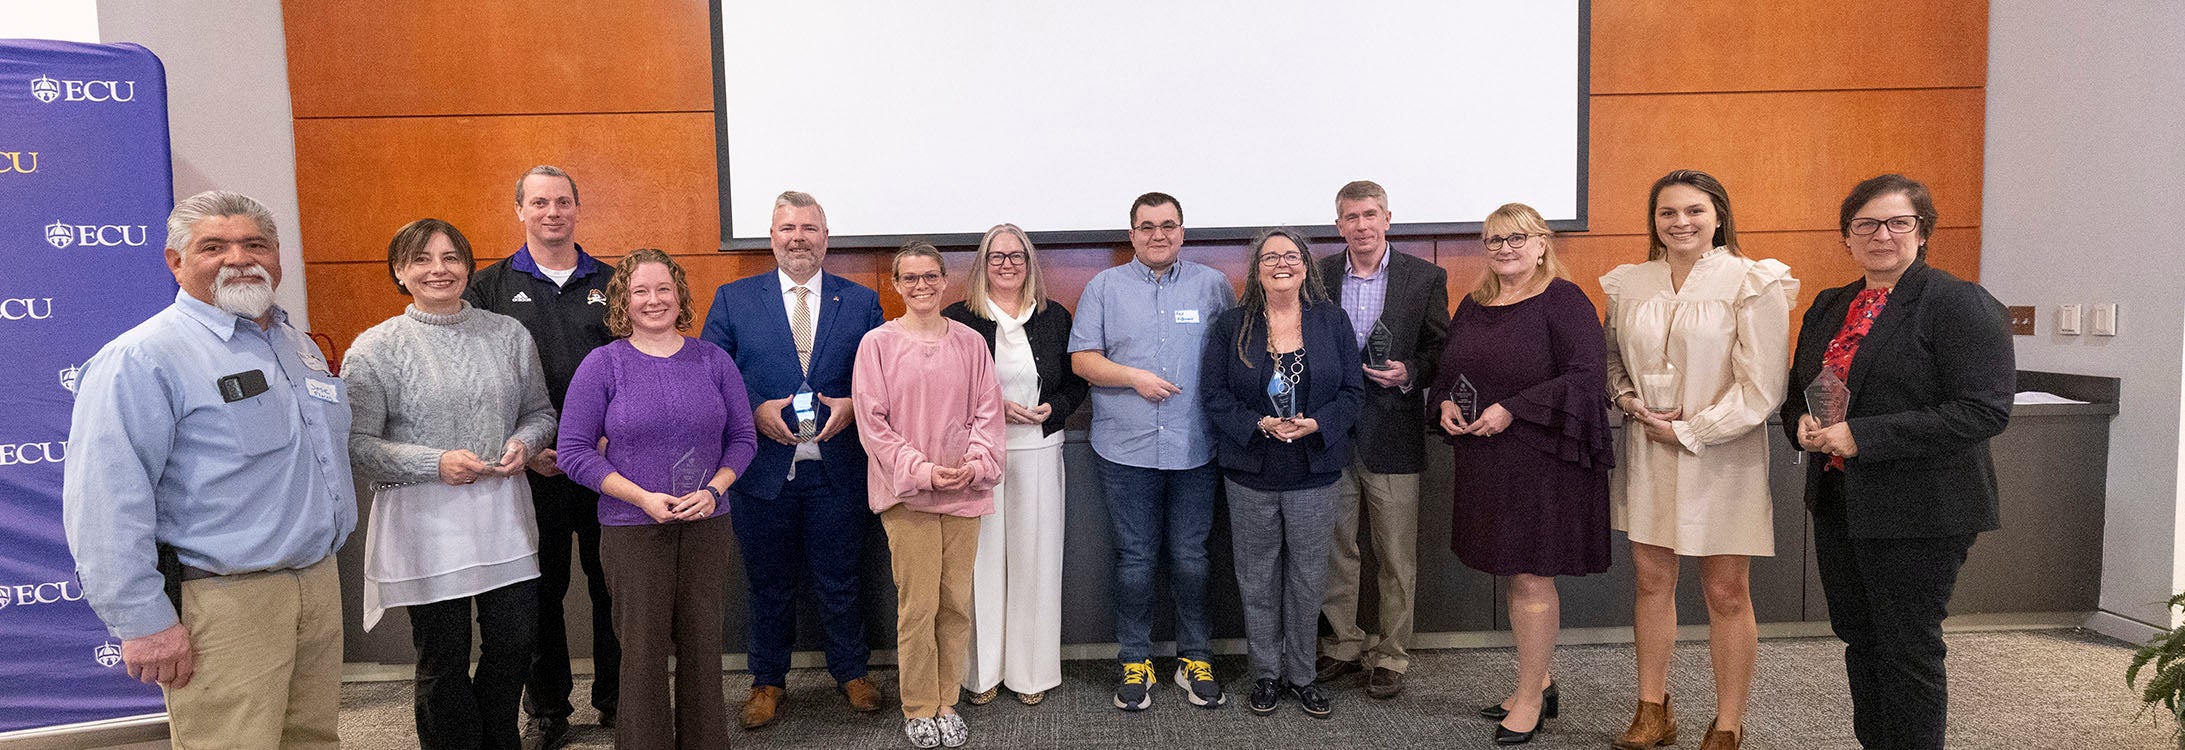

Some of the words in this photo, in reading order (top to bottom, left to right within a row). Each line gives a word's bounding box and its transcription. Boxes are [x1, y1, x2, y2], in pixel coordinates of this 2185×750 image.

[61, 80, 135, 102] ECU
[75, 225, 148, 246] ECU
[0, 441, 68, 465] ECU
[13, 581, 84, 605] ECU
